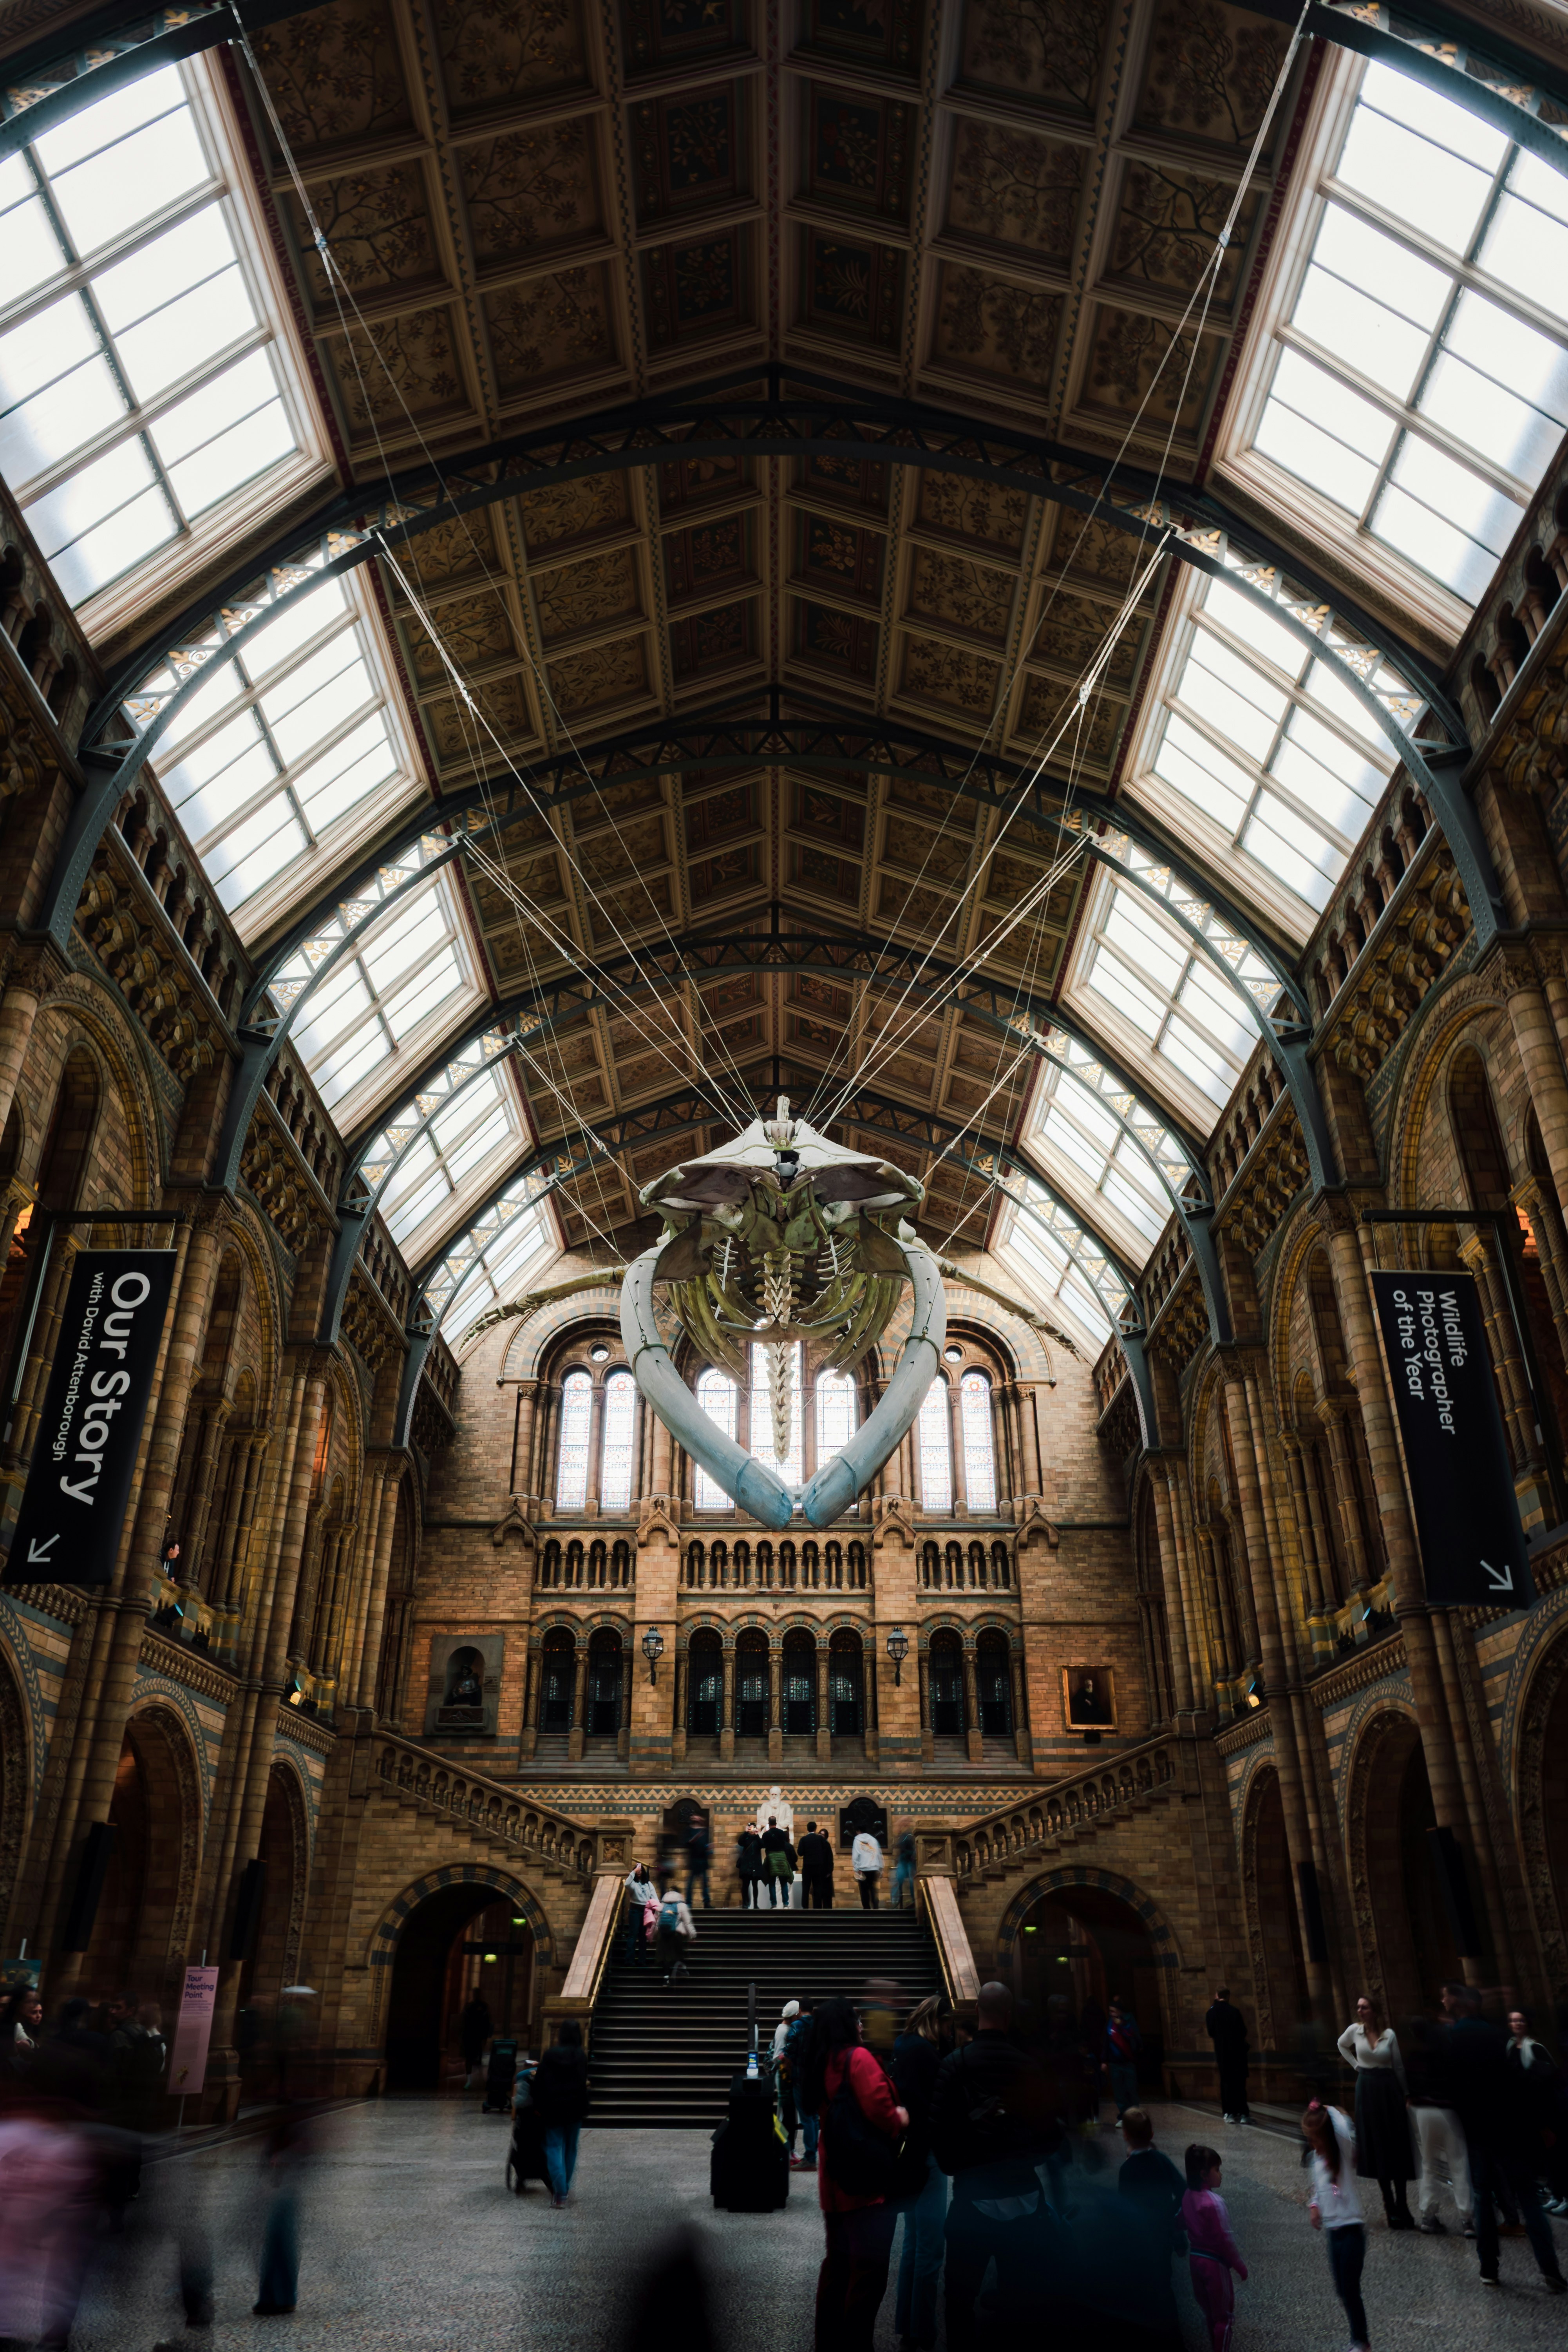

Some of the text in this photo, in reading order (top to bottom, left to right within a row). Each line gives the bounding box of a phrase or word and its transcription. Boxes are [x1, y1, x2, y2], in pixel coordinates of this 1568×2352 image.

[1229, 170, 1290, 358] PINVS SYLVESTRIS
[286, 284, 316, 357] PERSICA
[382, 612, 418, 715] THEOBROMA CACAO
[1131, 673, 1148, 711] CITRVS
[52, 1272, 104, 1461] with David Attenborough
[1393, 1290, 1424, 1400] of the Year
[1416, 1291, 1455, 1434] Photographer
[1439, 1291, 1468, 1366] Wildlife
[60, 1272, 150, 1505] Our Story
